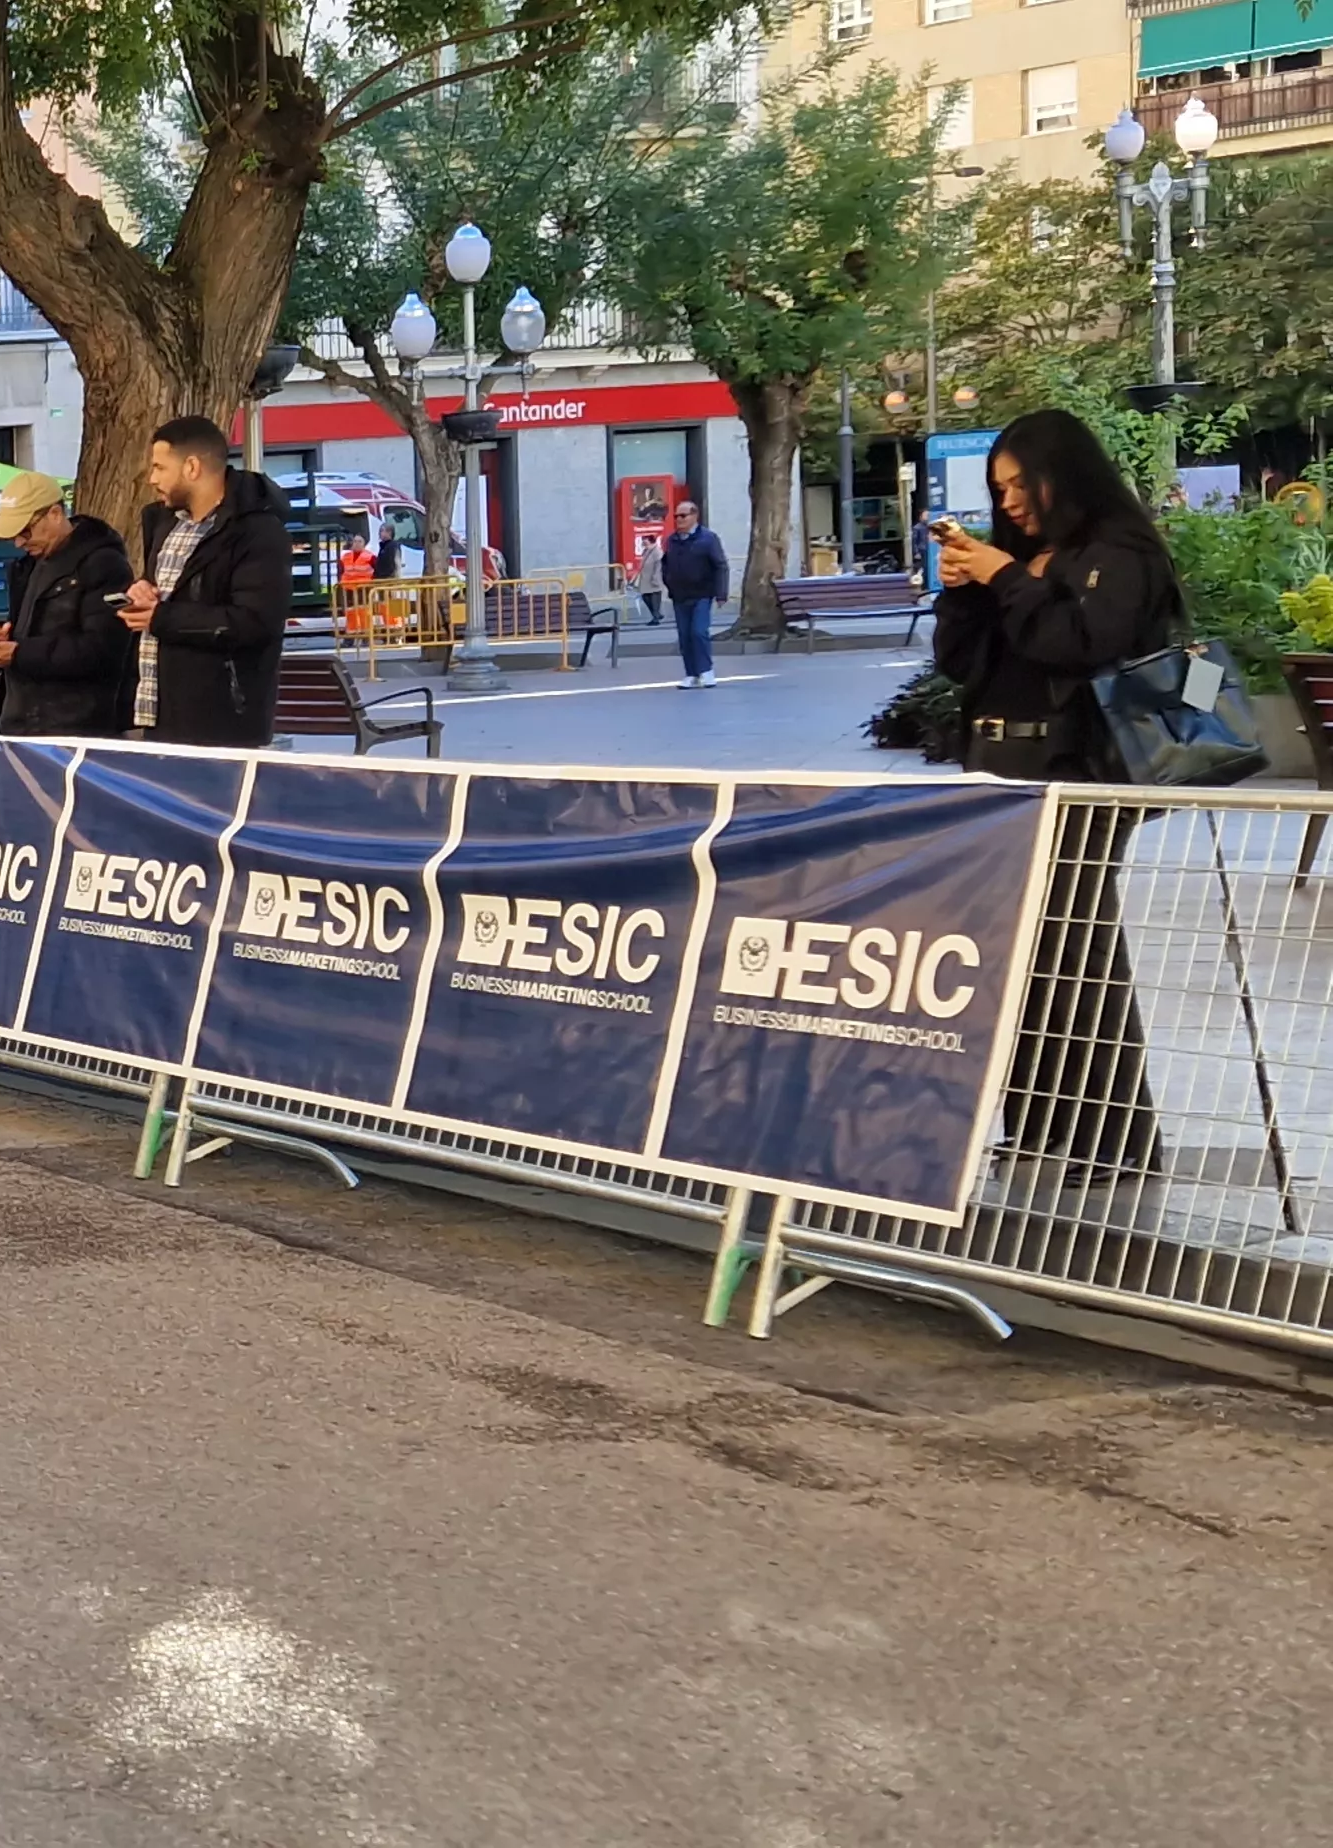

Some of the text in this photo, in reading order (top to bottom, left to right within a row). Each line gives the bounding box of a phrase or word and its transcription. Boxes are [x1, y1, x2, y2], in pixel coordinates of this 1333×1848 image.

[97, 854, 207, 926] ESIC
[280, 875, 411, 954] ESIC
[506, 897, 666, 984] ESIC
[780, 920, 981, 1019] ESIC
